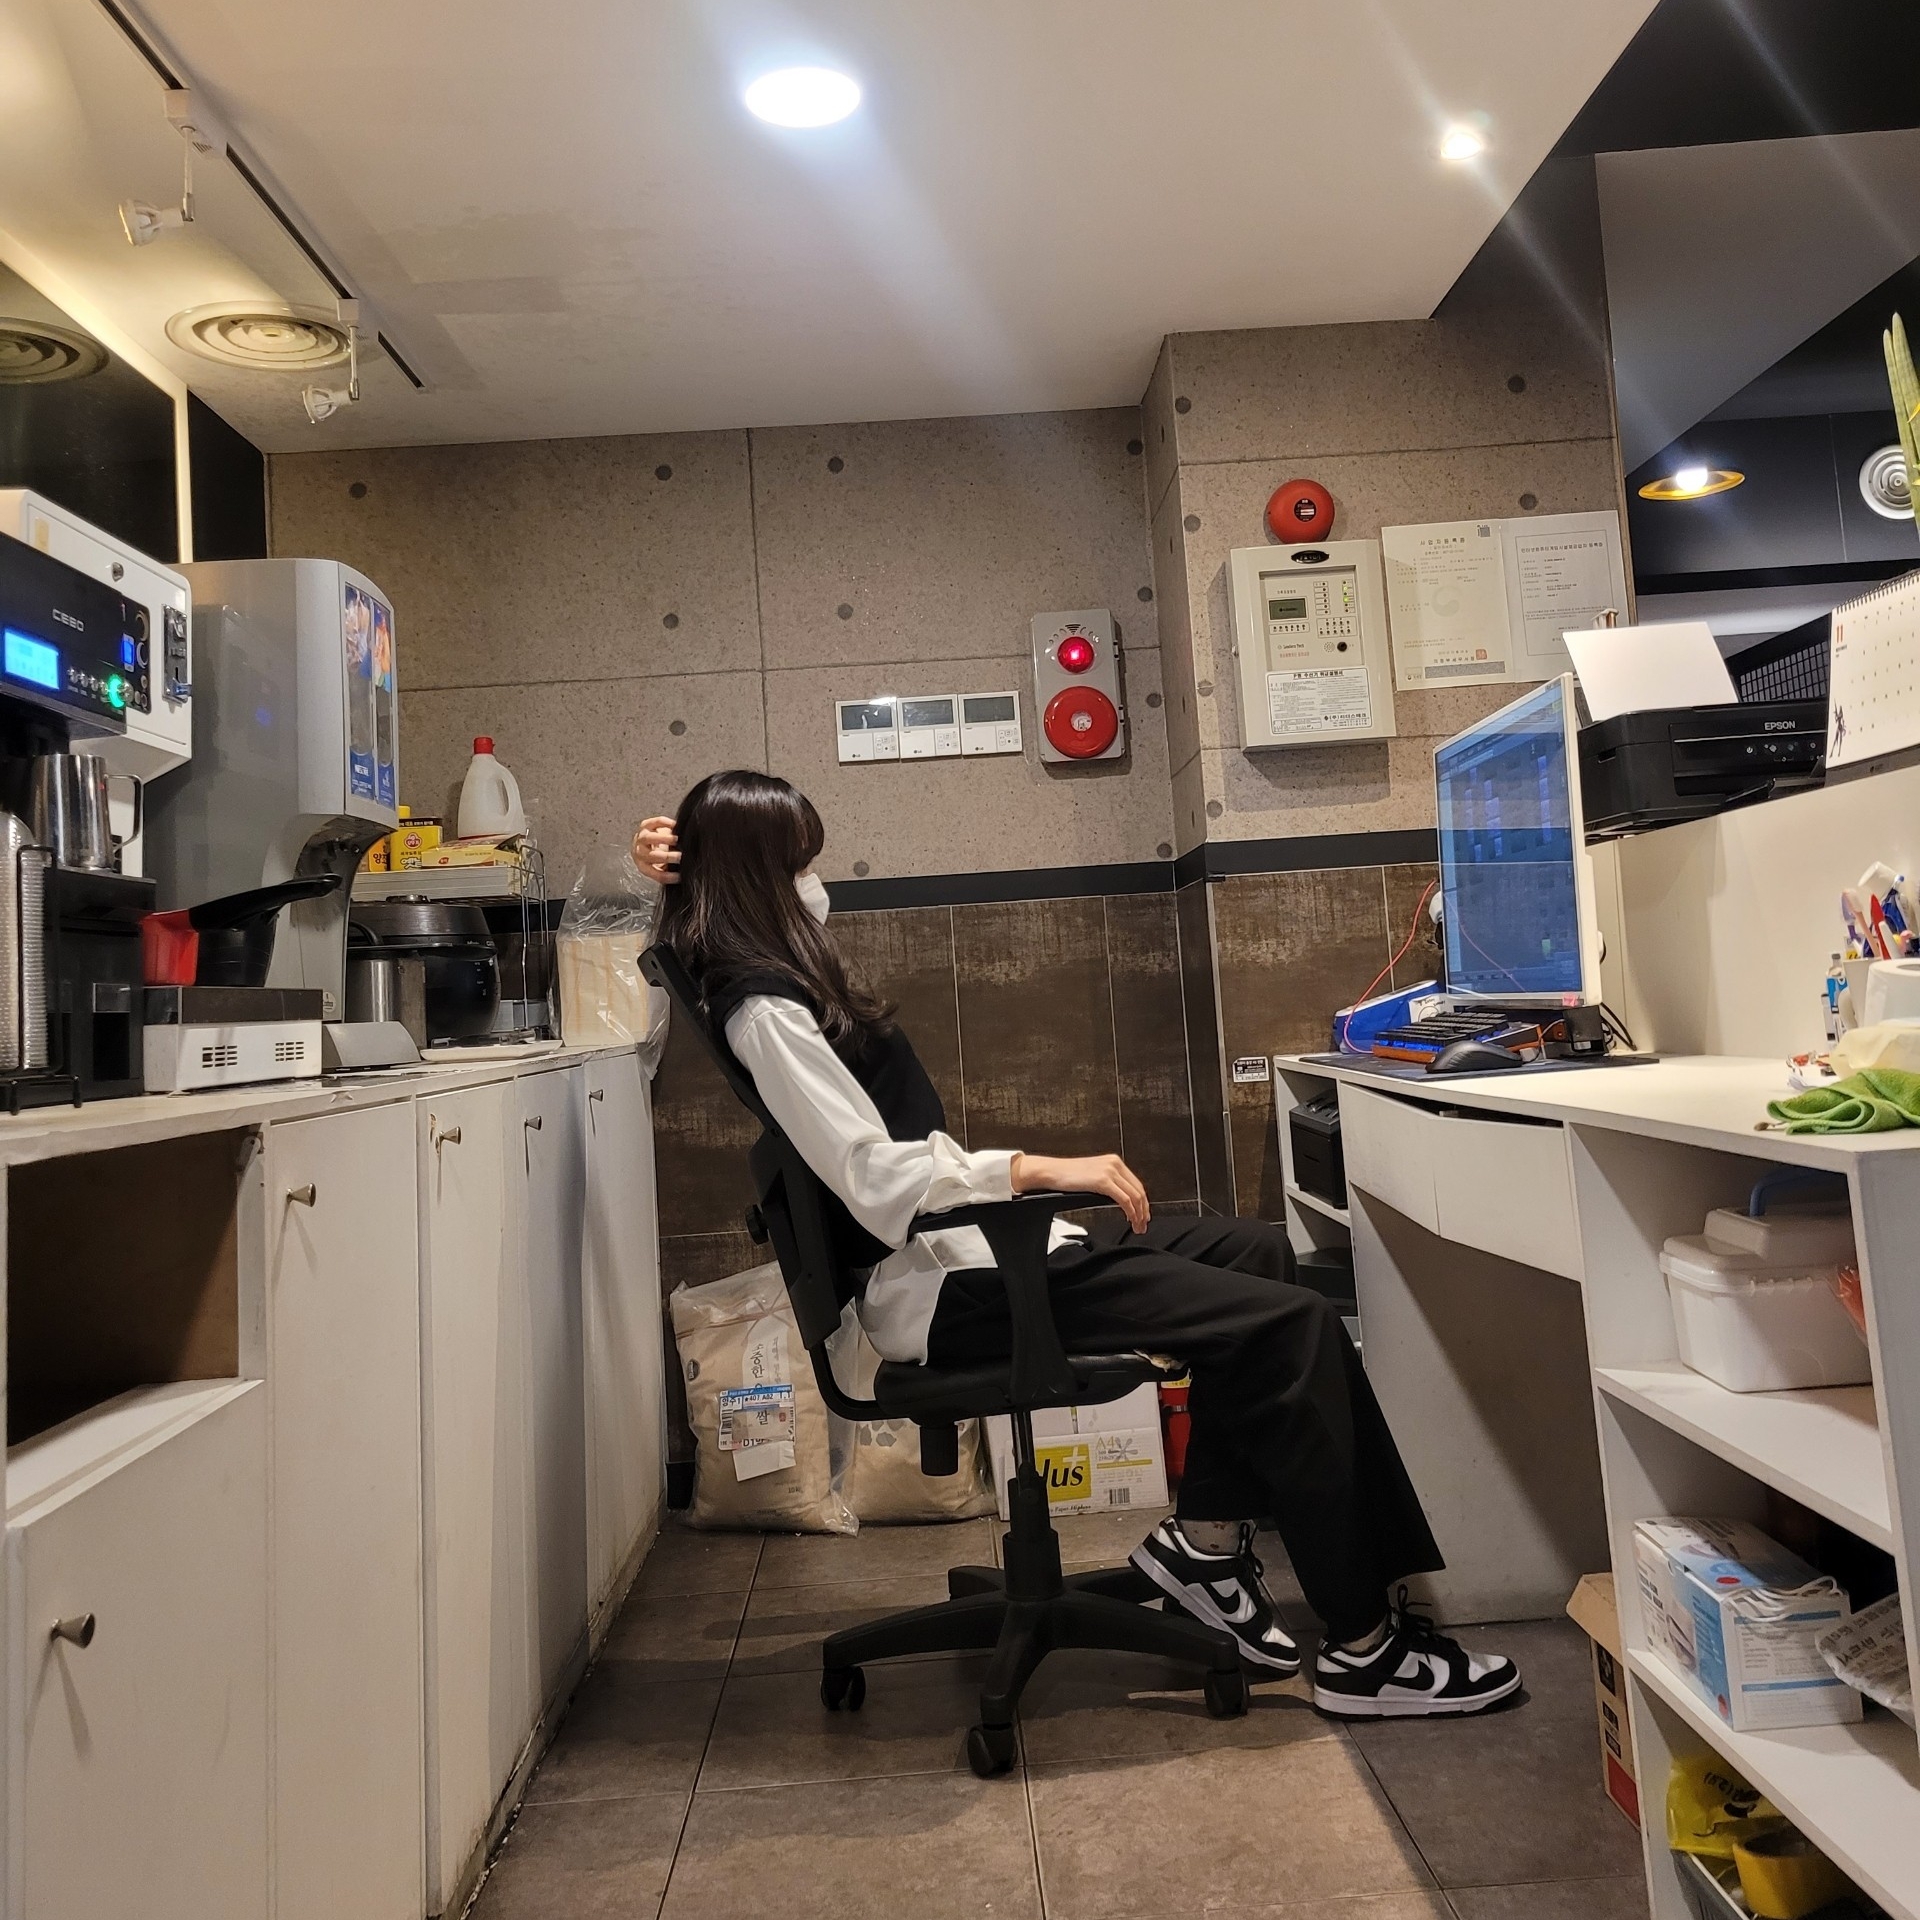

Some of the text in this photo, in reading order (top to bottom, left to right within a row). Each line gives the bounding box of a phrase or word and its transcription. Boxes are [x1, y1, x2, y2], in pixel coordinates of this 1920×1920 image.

[1764, 720, 1796, 731] EPSON
[1096, 1435, 1115, 1450] A4
[1042, 1458, 1084, 1488] lus
